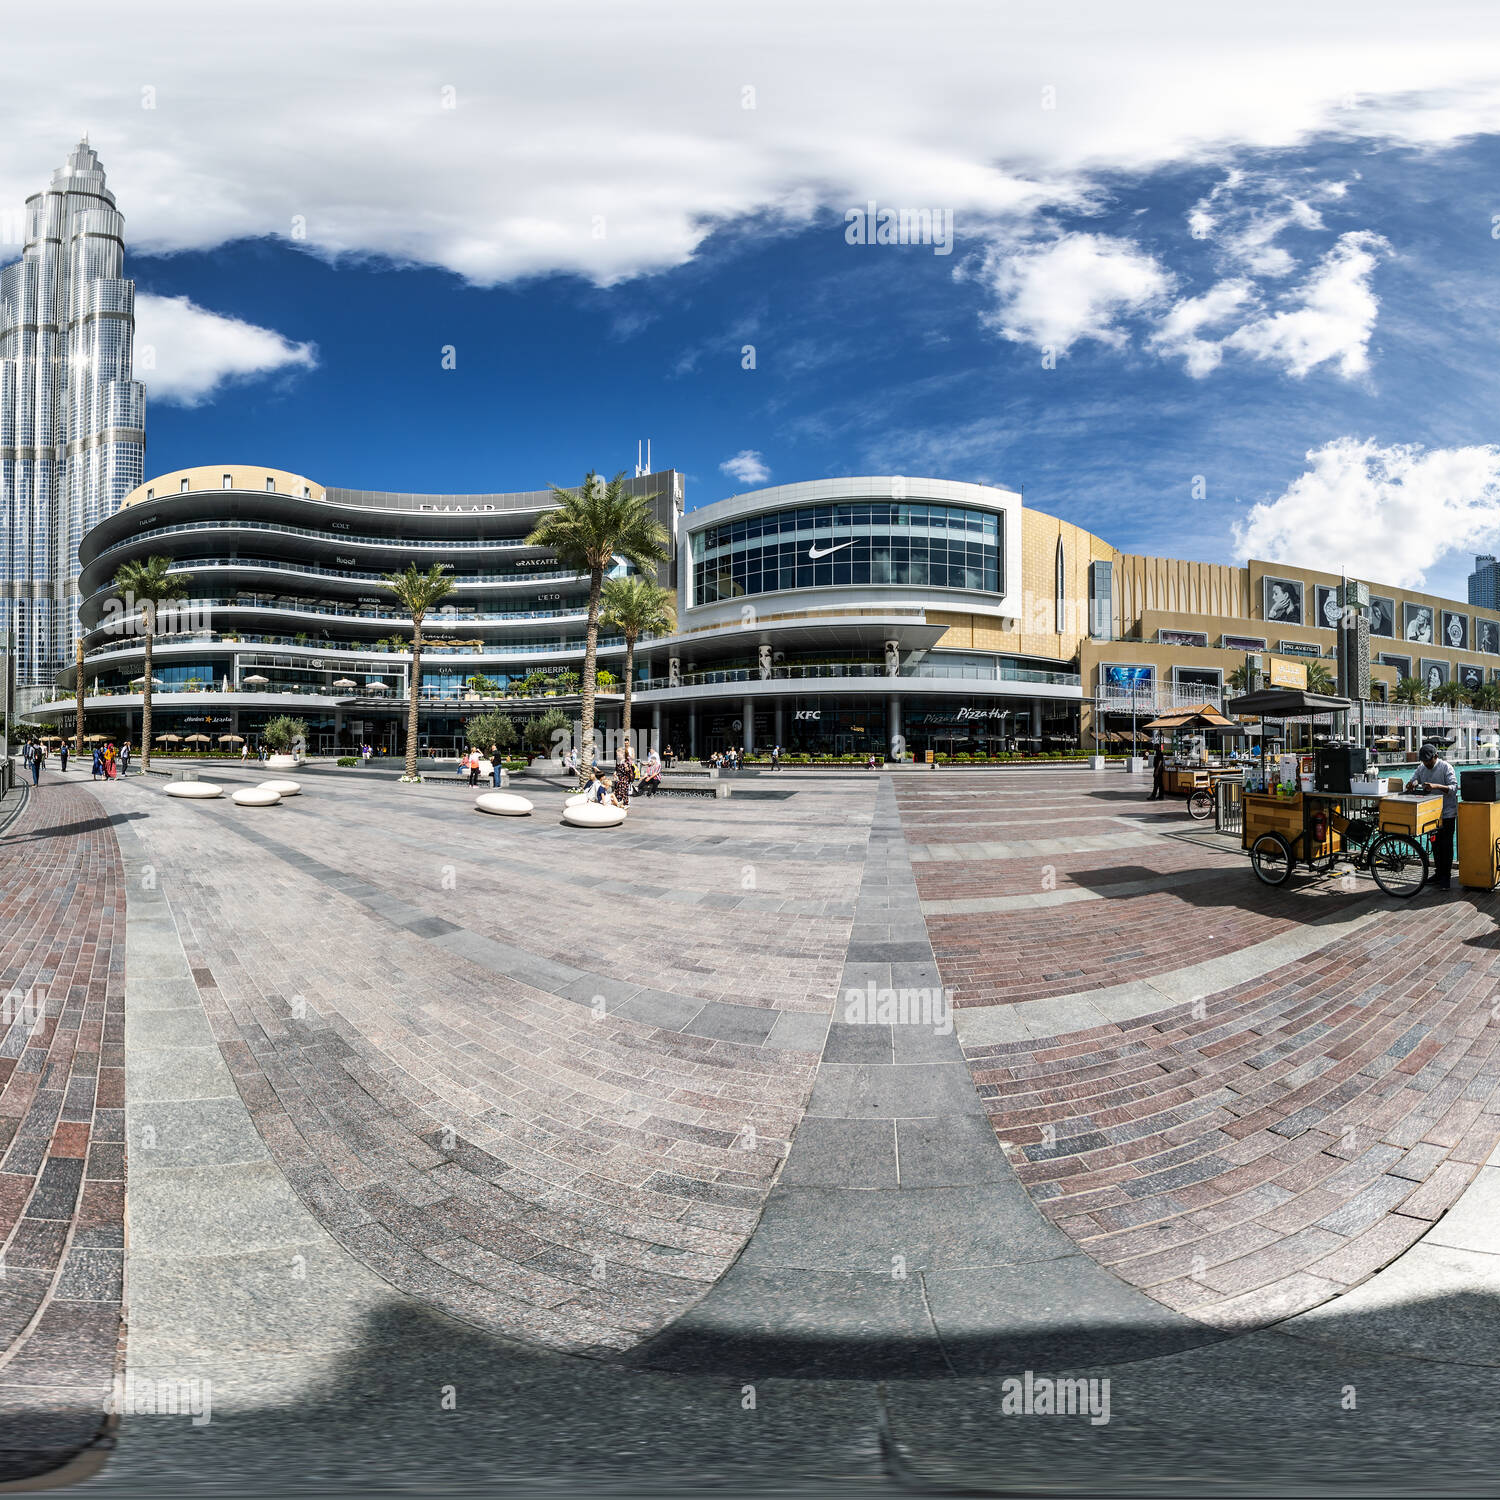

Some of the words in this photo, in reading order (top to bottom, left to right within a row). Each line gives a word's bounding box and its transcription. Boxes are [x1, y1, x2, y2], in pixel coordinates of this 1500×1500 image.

[525, 666, 570, 675] BURBERRY
[795, 711, 821, 720] KFC
[957, 707, 988, 720] Pizza
[988, 707, 1011, 719] Hut
